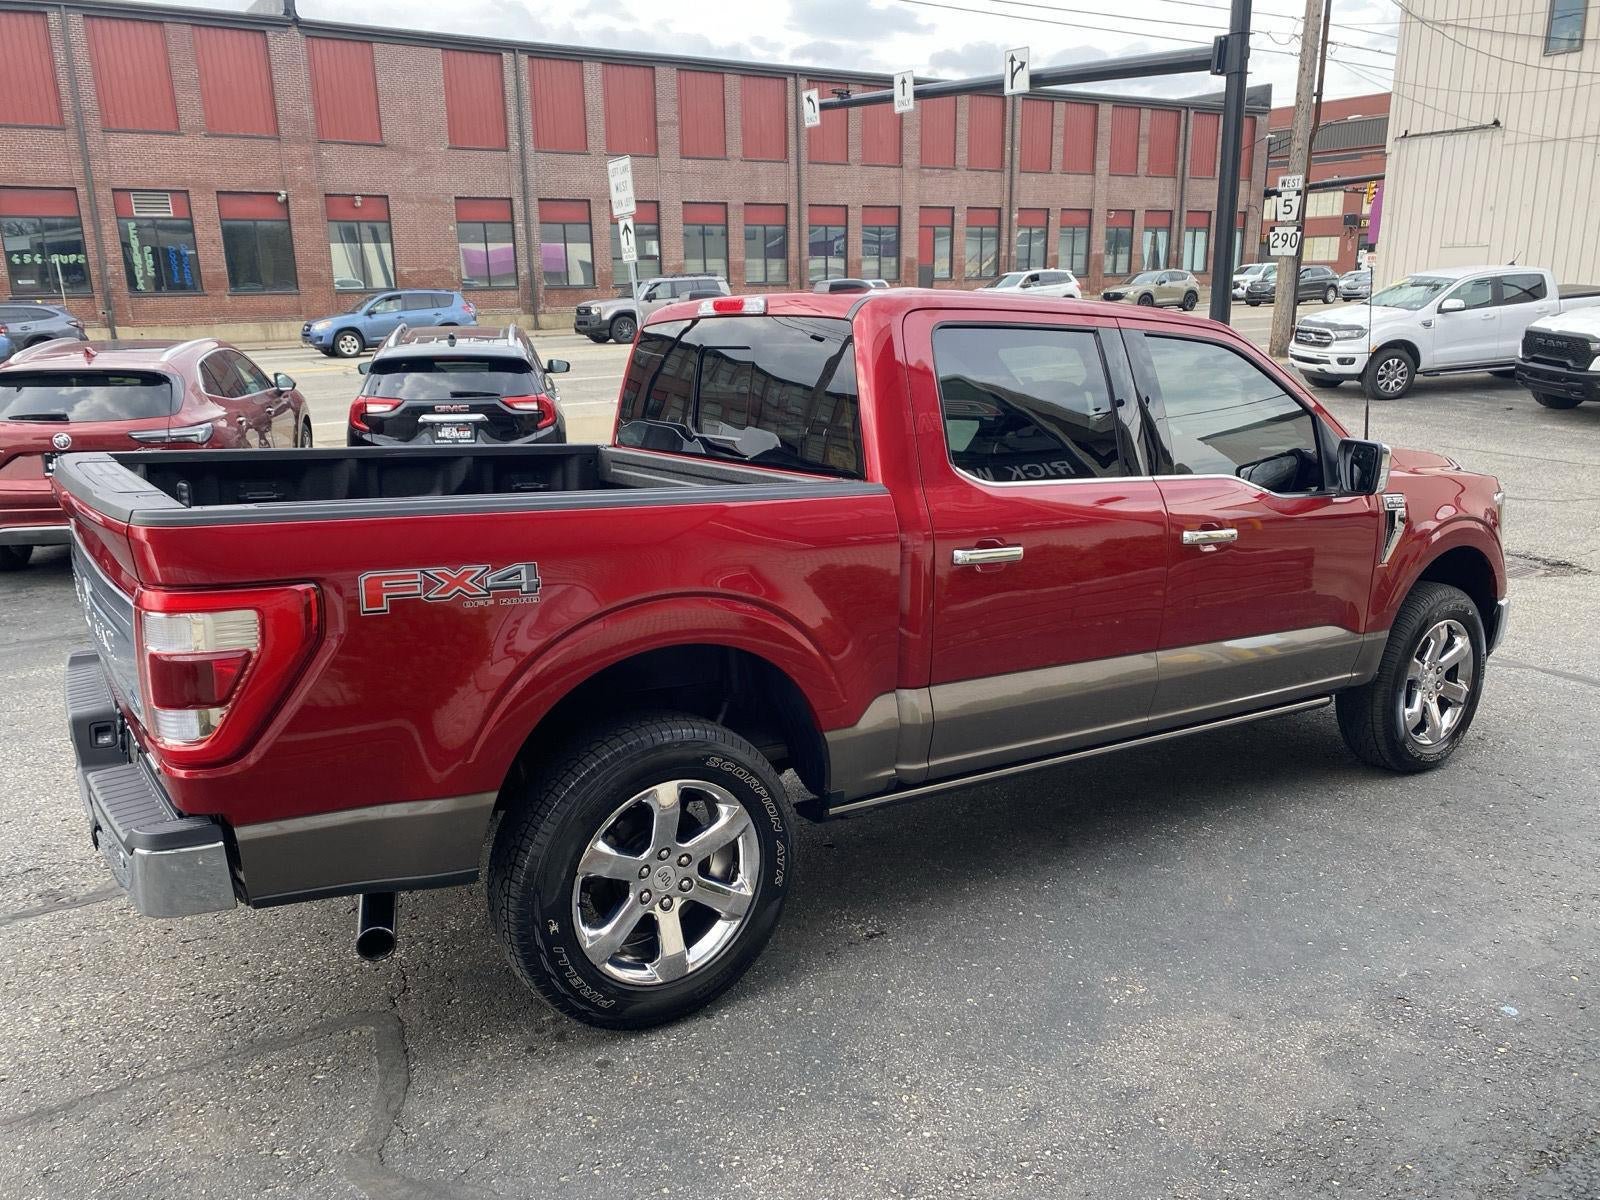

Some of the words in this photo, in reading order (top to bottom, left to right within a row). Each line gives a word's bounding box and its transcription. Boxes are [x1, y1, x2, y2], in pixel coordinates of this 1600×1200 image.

[896, 96, 912, 108] ONLY
[1280, 178, 1300, 189] WEST
[1282, 198, 1293, 215] 5
[1271, 231, 1299, 249] 290
[434, 404, 470, 412] GMC
[358, 562, 541, 616] FX4
[463, 599, 494, 608] OFF
[499, 596, 541, 606] ROAD
[705, 756, 783, 832] SCORPION
[774, 840, 785, 886] ATR
[552, 946, 616, 1008] PIRELLI
